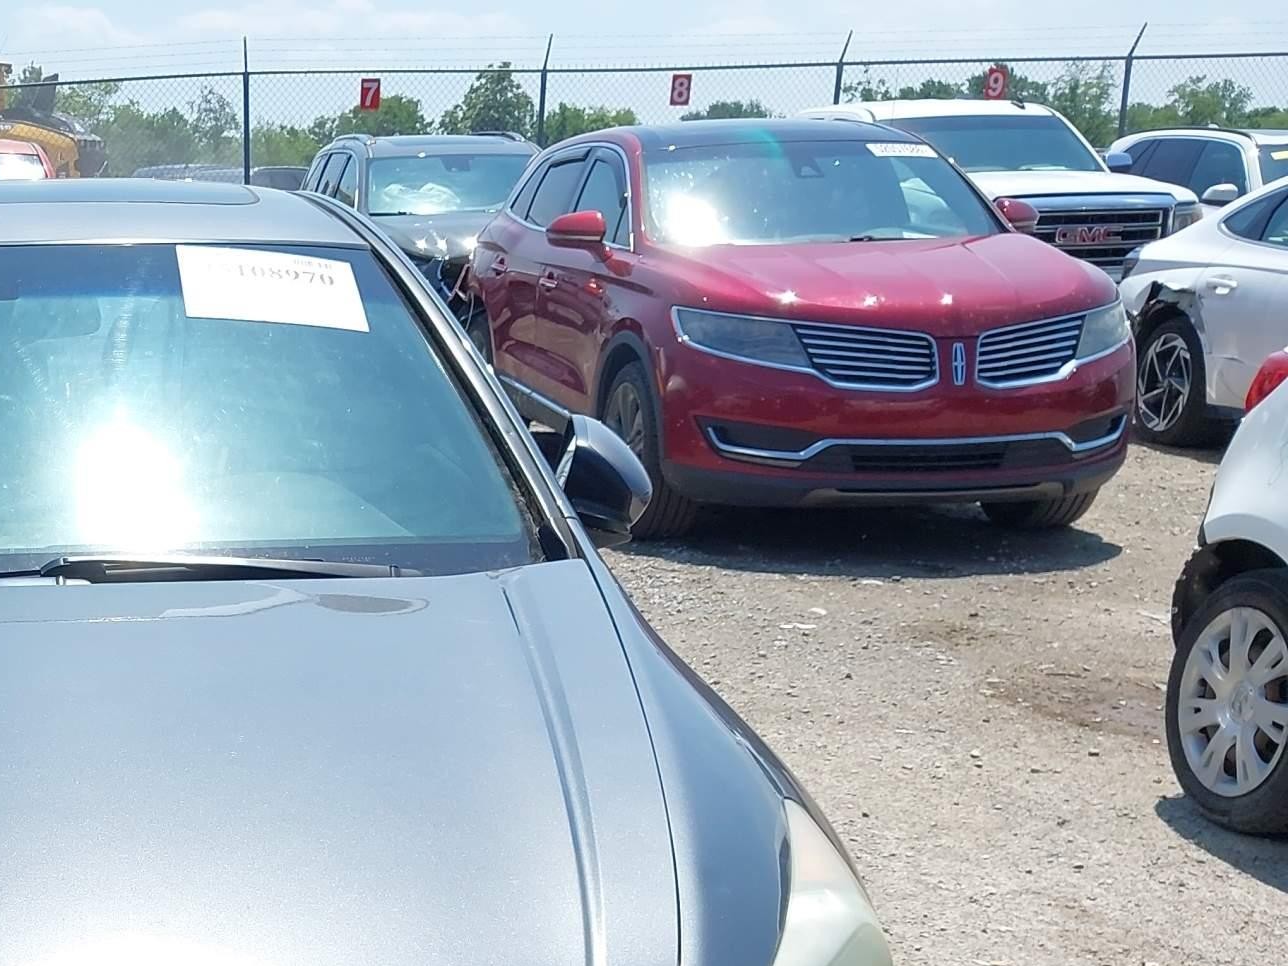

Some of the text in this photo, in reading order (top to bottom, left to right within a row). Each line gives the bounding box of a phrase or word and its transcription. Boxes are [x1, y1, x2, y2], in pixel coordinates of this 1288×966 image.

[363, 82, 379, 107] 7
[673, 77, 689, 103] 8
[988, 71, 1004, 97] 9
[1055, 225, 1123, 244] GMC
